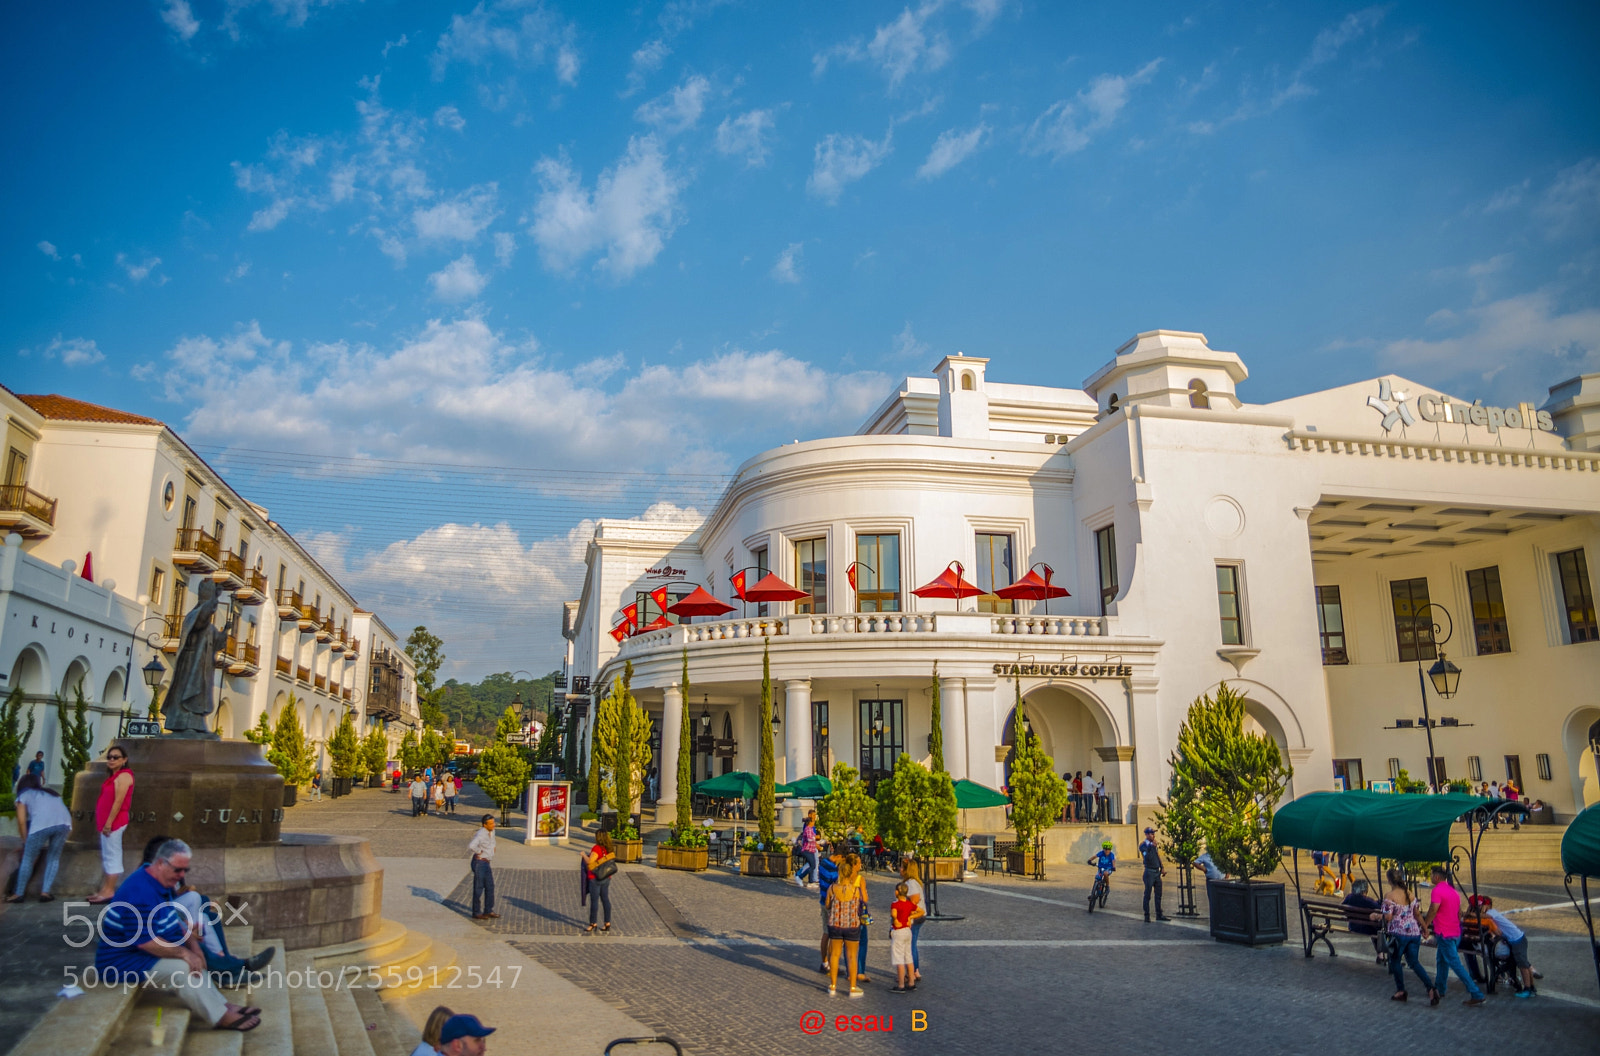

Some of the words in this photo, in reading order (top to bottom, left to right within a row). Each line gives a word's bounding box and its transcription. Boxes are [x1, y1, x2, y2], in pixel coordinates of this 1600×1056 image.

[1418, 393, 1554, 433] Cinépolis
[31, 615, 131, 656] KLOSTER
[992, 664, 1077, 676] STARBUCKS
[1080, 665, 1133, 676] COFFEE
[200, 808, 264, 824] JUAN
